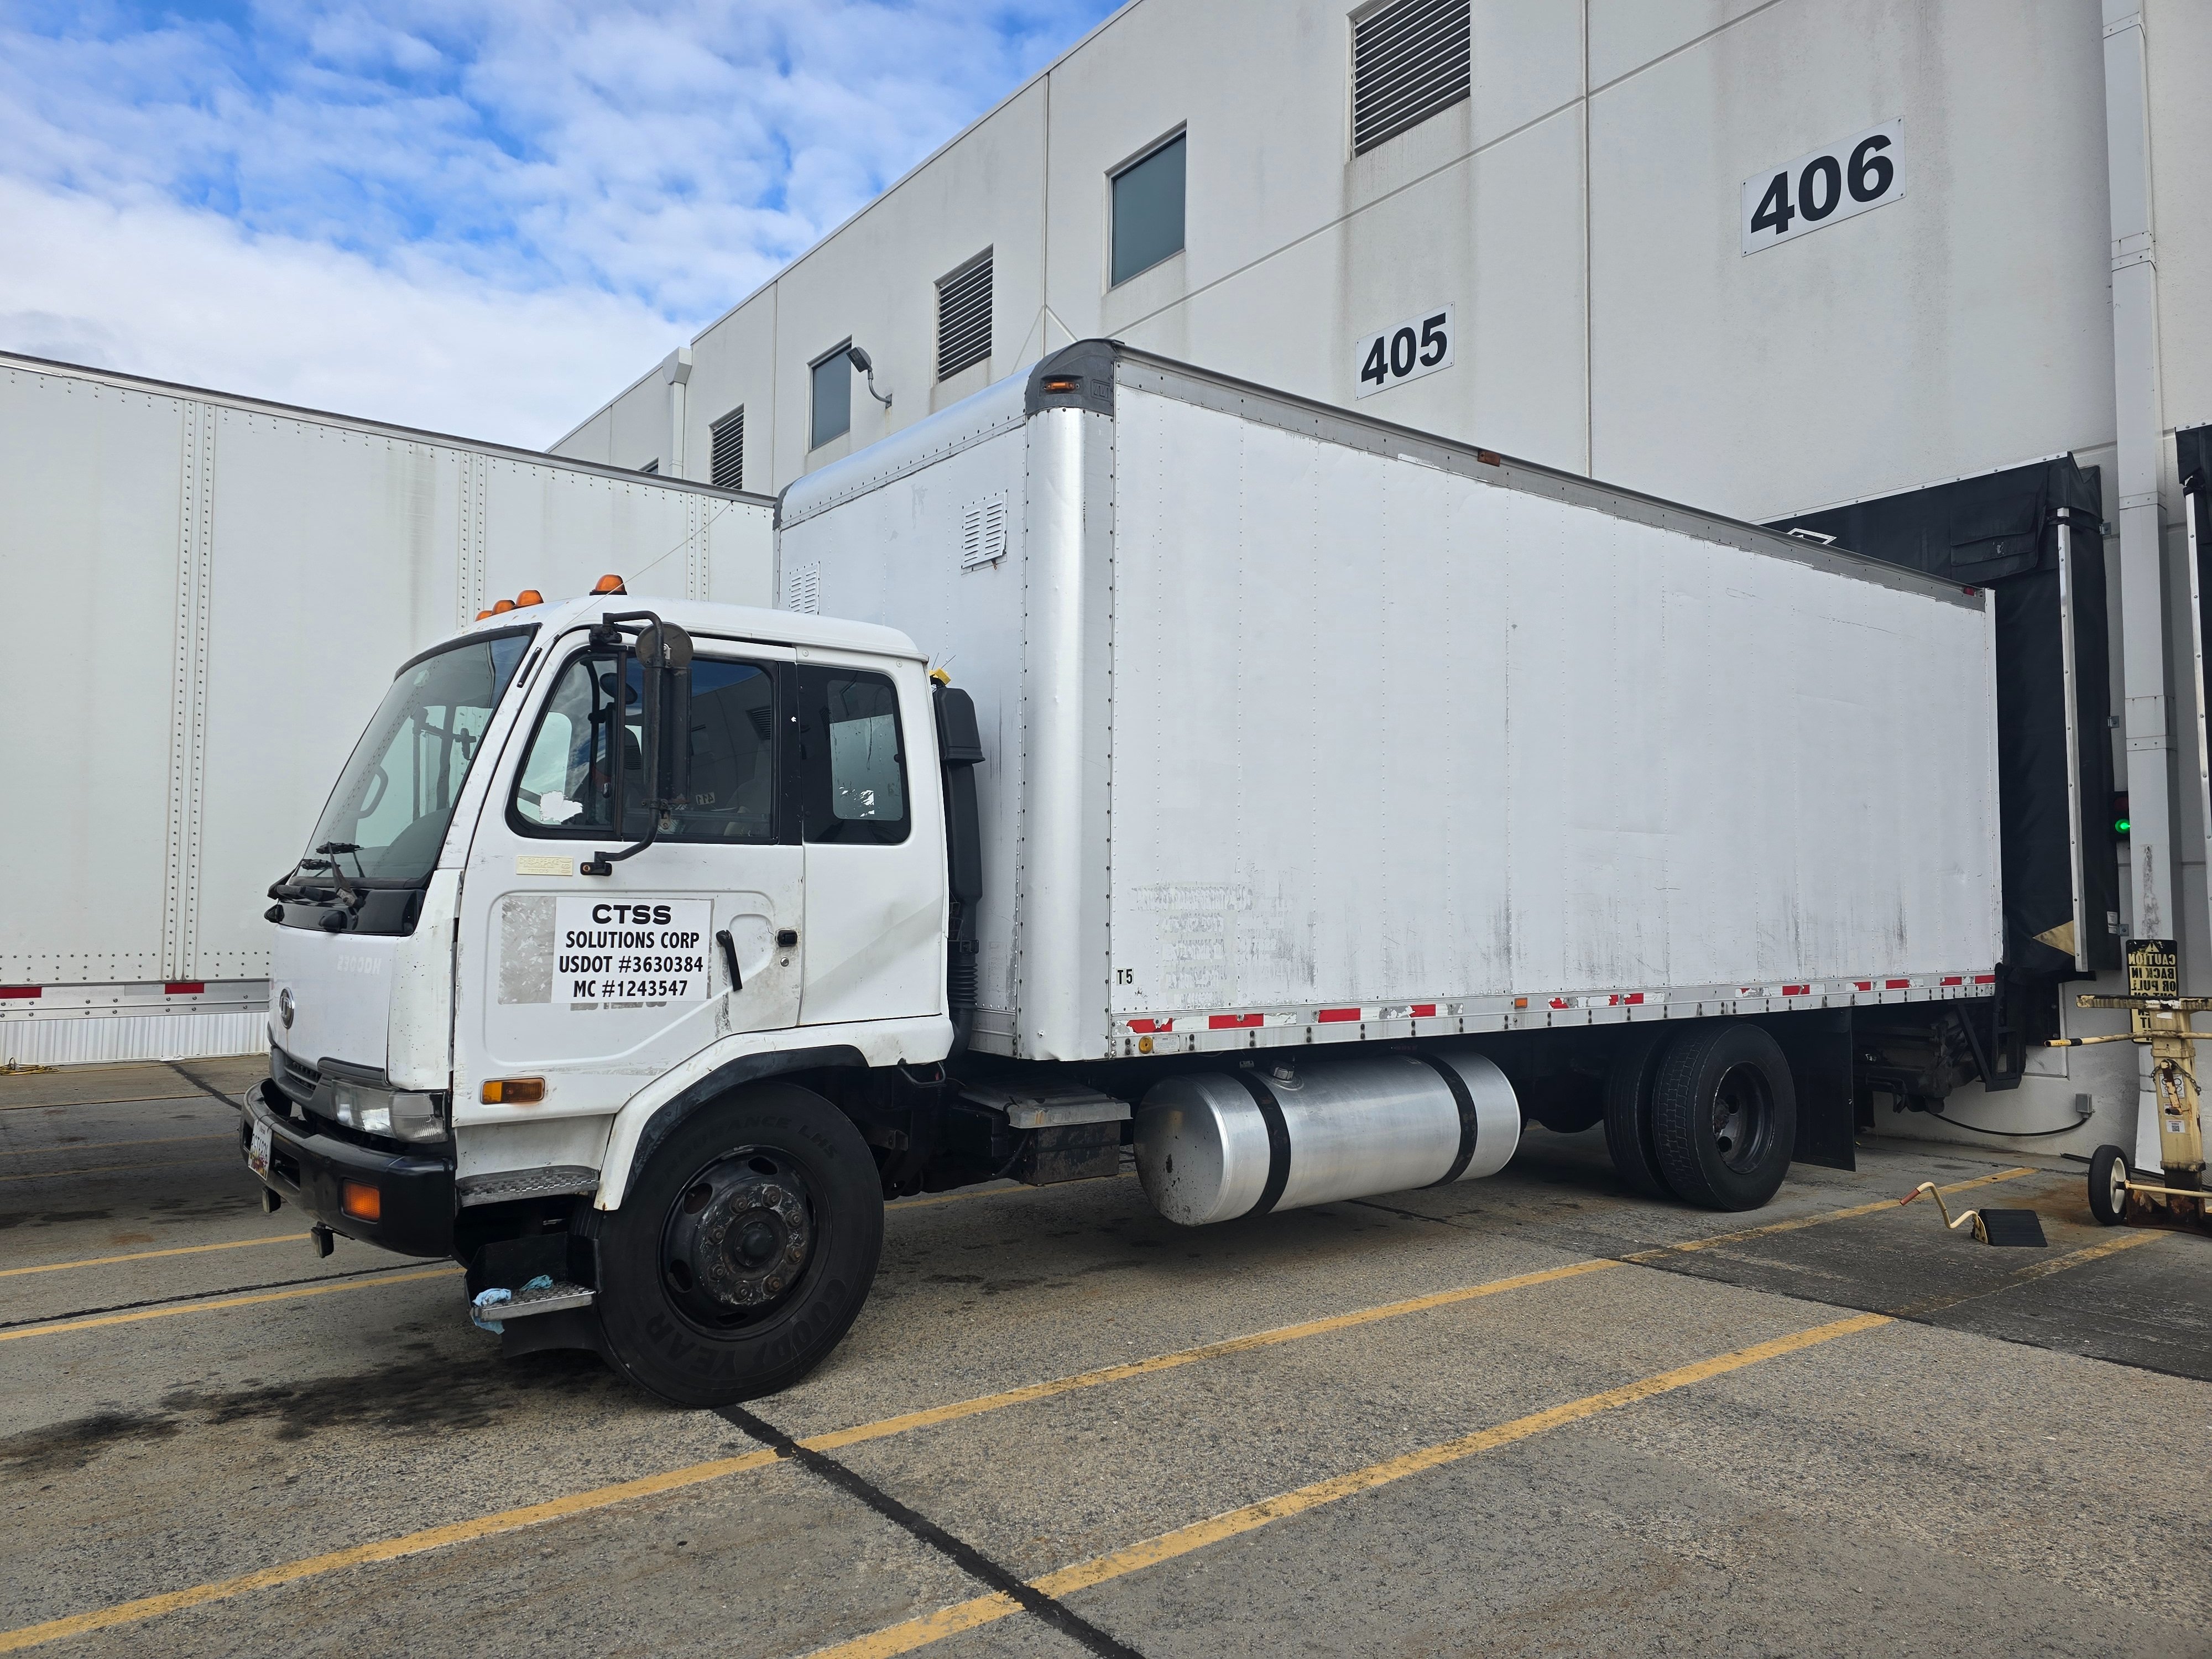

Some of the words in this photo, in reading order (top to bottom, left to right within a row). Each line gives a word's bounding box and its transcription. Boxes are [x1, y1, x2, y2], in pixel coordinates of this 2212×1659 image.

[1751, 135, 1893, 234] 406
[1361, 312, 1447, 385] 405
[592, 904, 671, 925] CTSS
[566, 931, 655, 948] SOLUTIONS
[660, 931, 700, 948] CORP
[559, 956, 613, 973] USDOT
[618, 956, 703, 973] #3630384
[573, 980, 596, 998] MC
[602, 980, 687, 998] #1243547
